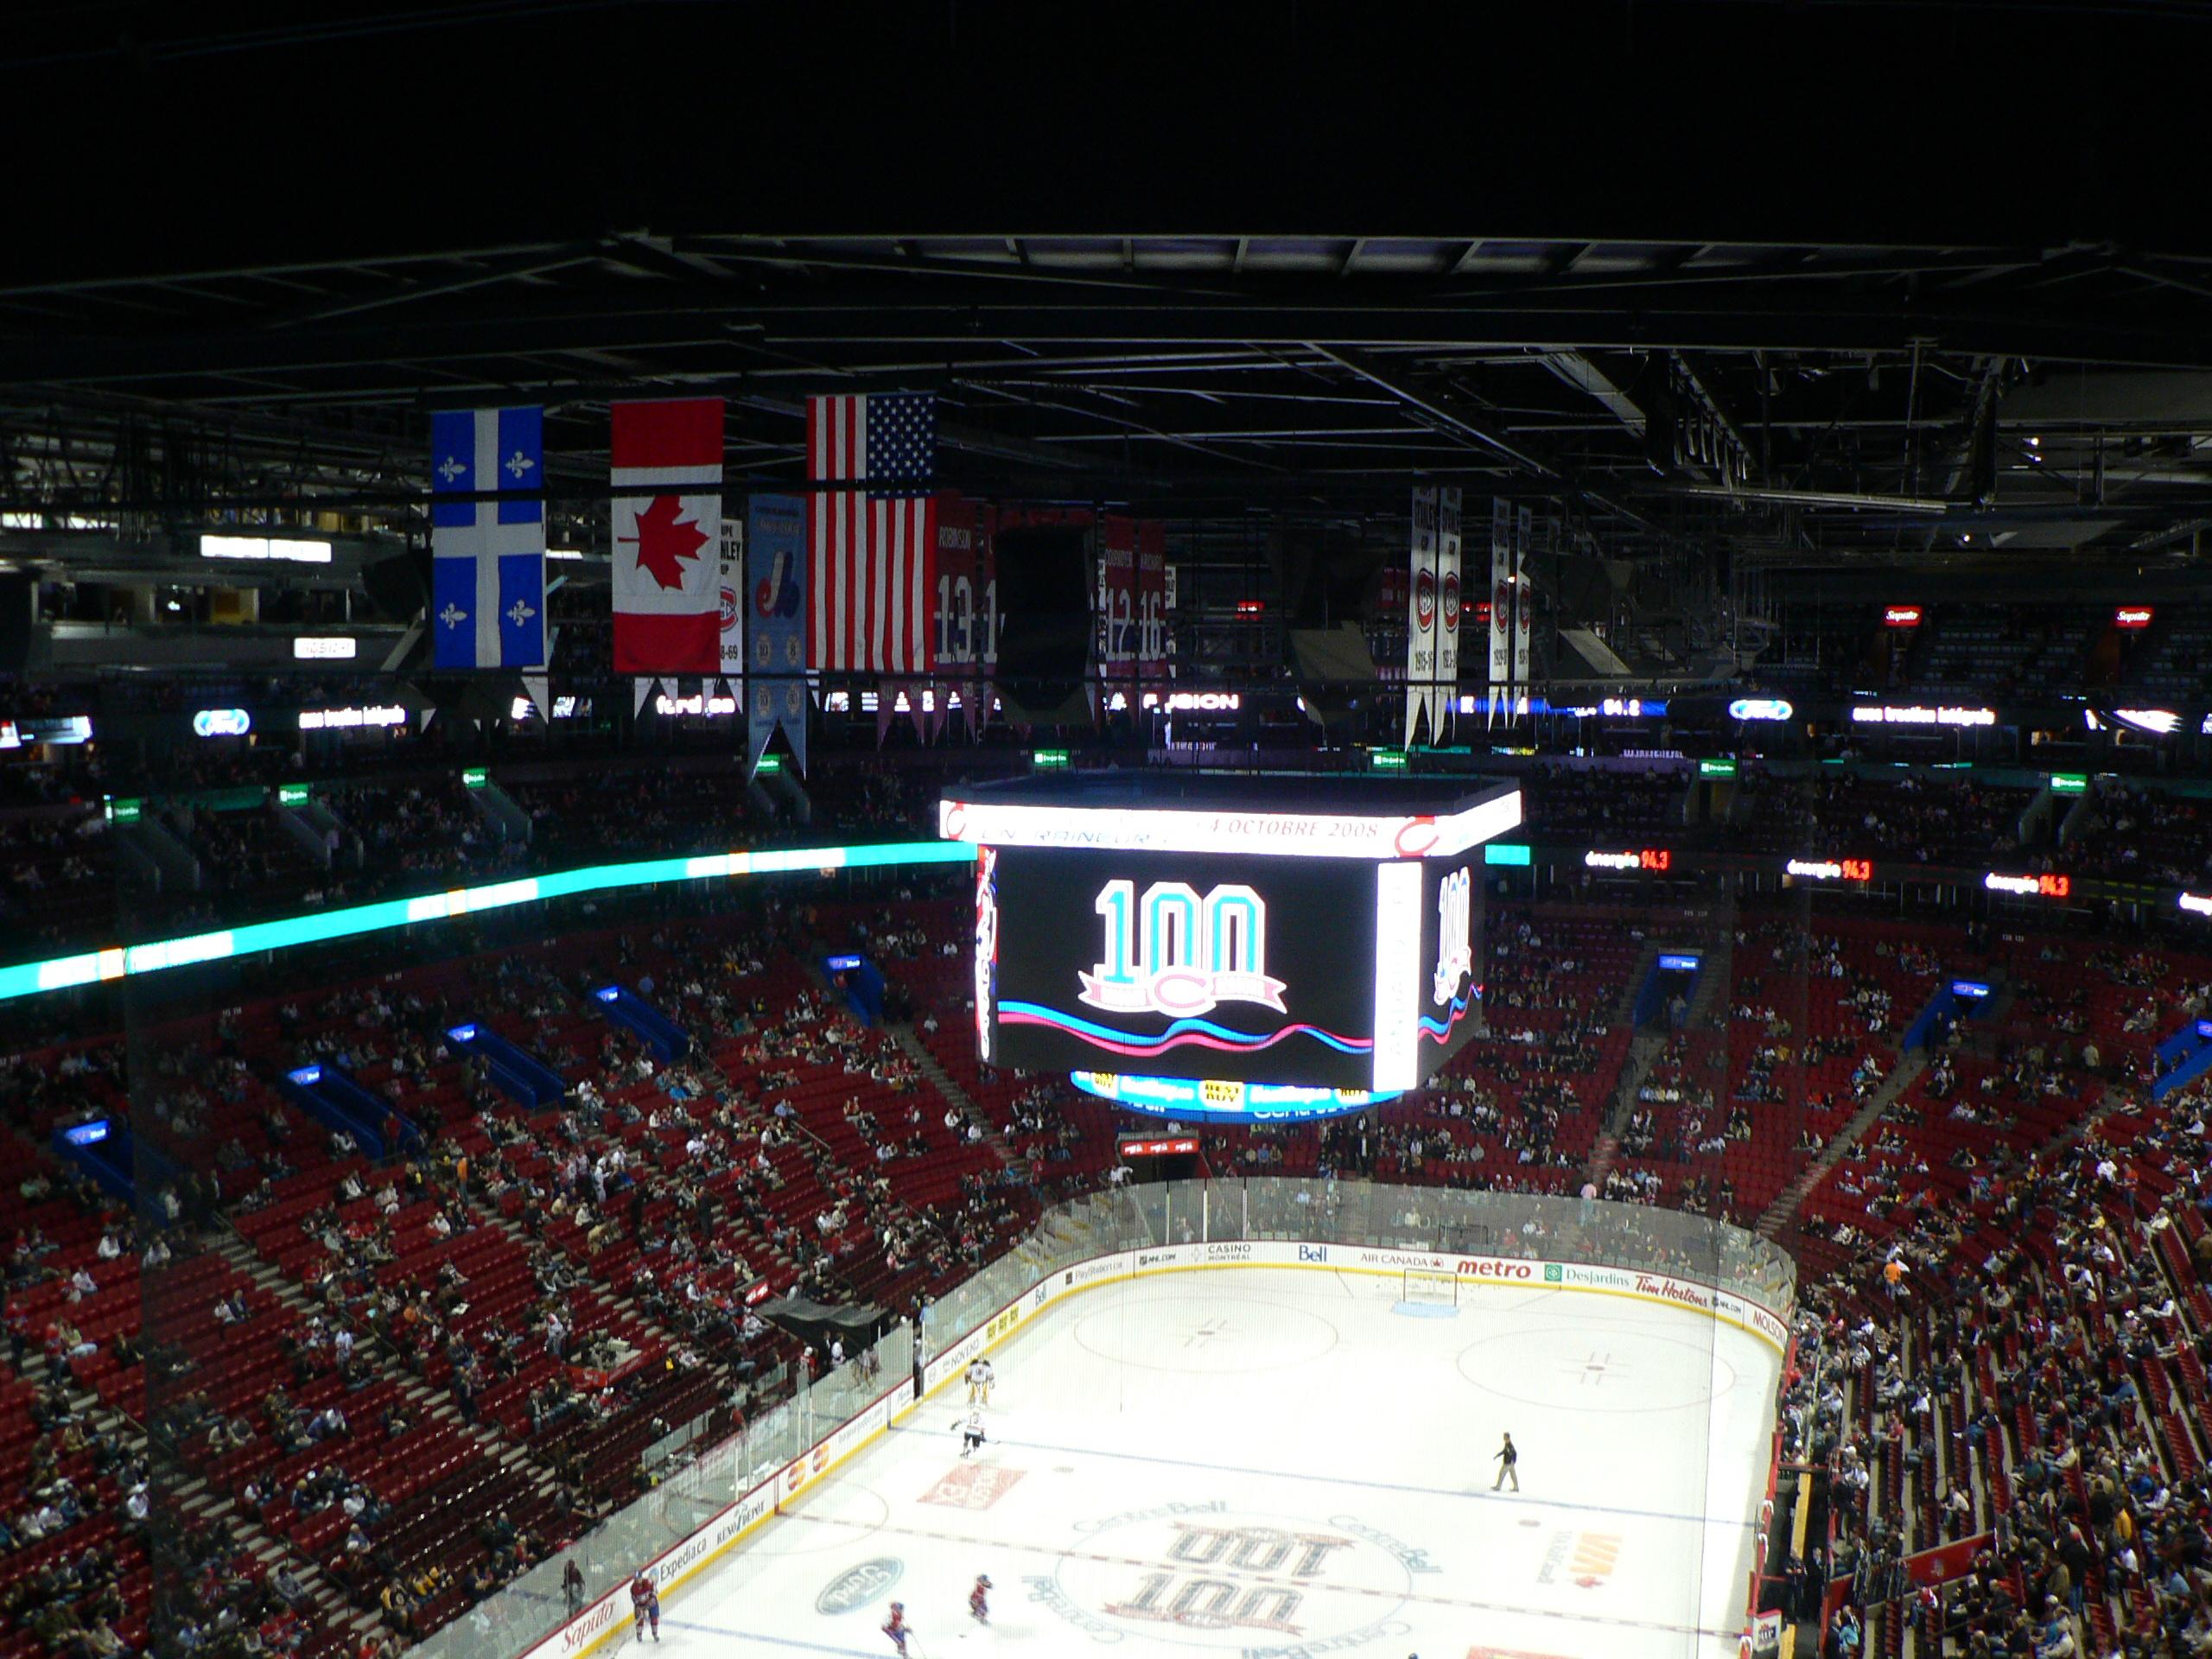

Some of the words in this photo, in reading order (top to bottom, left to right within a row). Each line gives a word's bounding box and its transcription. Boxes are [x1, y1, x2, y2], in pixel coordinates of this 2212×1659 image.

[938, 525, 972, 550] ROBINSON
[938, 574, 973, 664] 19
[1106, 588, 1132, 662] 12
[1139, 589, 1161, 662] 16
[1886, 610, 1919, 622] Saputo
[2117, 611, 2151, 622] Saputo
[721, 645, 738, 660] 8-69
[1228, 818, 1319, 837] OCTOBRE
[1326, 821, 1379, 839] 2008
[1642, 850, 1668, 869] 94.3
[1842, 860, 1870, 880] 94.3
[2039, 875, 2069, 896] 94.3
[1092, 880, 1265, 987] 100
[1205, 1084, 1240, 1094] BEST
[1205, 1093, 1236, 1103] BUY
[1207, 1243, 1252, 1254] CASINO
[1299, 1244, 1328, 1263] Bell
[1360, 1251, 1379, 1263] AIR
[1380, 1255, 1429, 1268] CANADA
[1456, 1260, 1532, 1280] metro
[1566, 1268, 1630, 1287] Desjardins
[1636, 1274, 1660, 1296] Tim
[1661, 1280, 1709, 1308] Hortons
[1752, 1309, 1787, 1344] MOLSON
[659, 1537, 708, 1583] Expedia.ca
[1118, 1573, 1304, 1624] 100
[562, 1601, 616, 1653] Saputo
